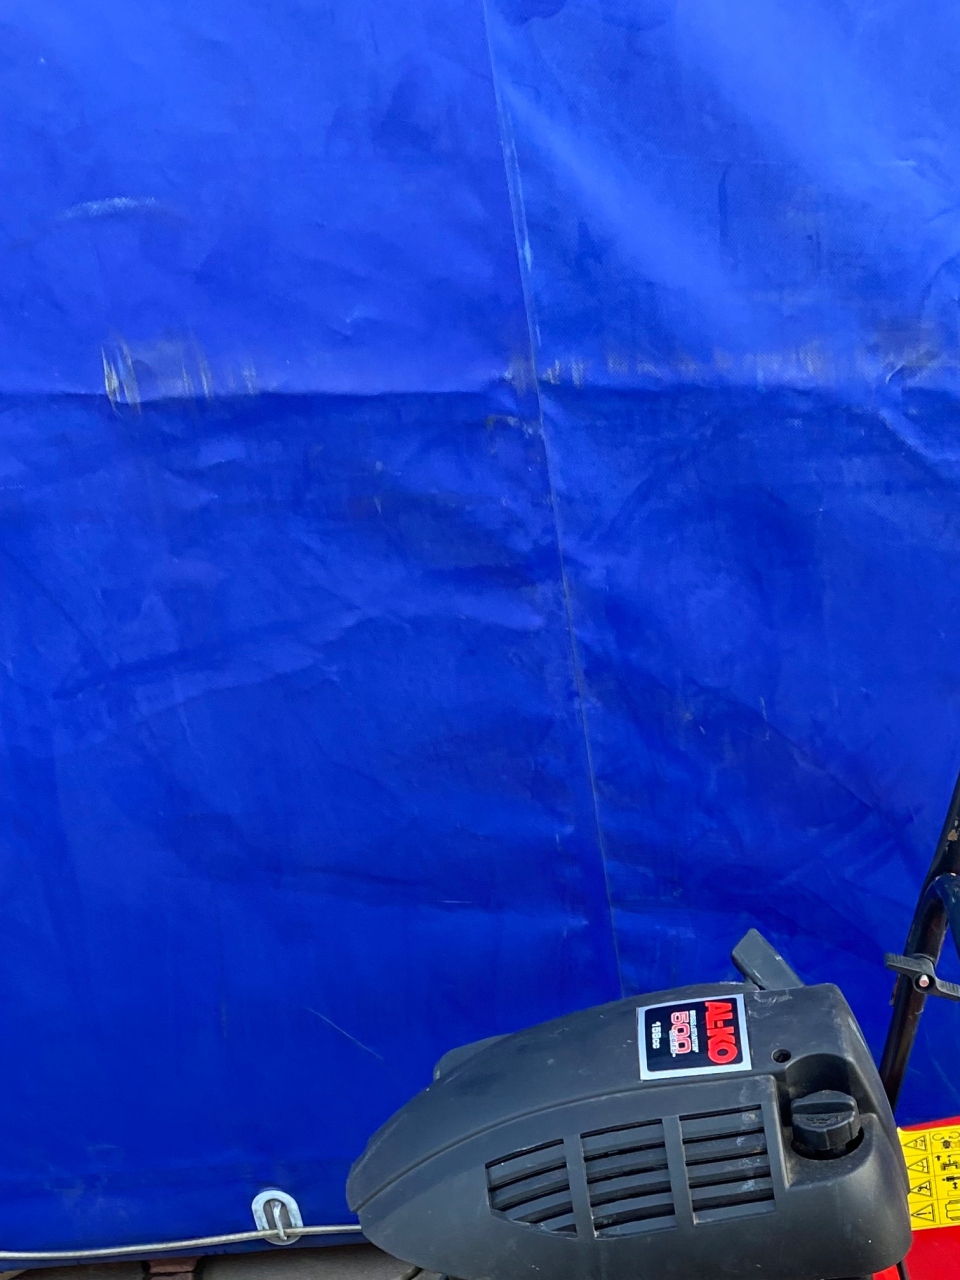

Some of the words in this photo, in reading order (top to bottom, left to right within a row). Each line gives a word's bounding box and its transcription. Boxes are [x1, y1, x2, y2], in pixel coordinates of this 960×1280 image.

[652, 1021, 661, 1049] 158cc
[671, 1011, 692, 1054] 500
[705, 1001, 738, 1064] AL-KO
